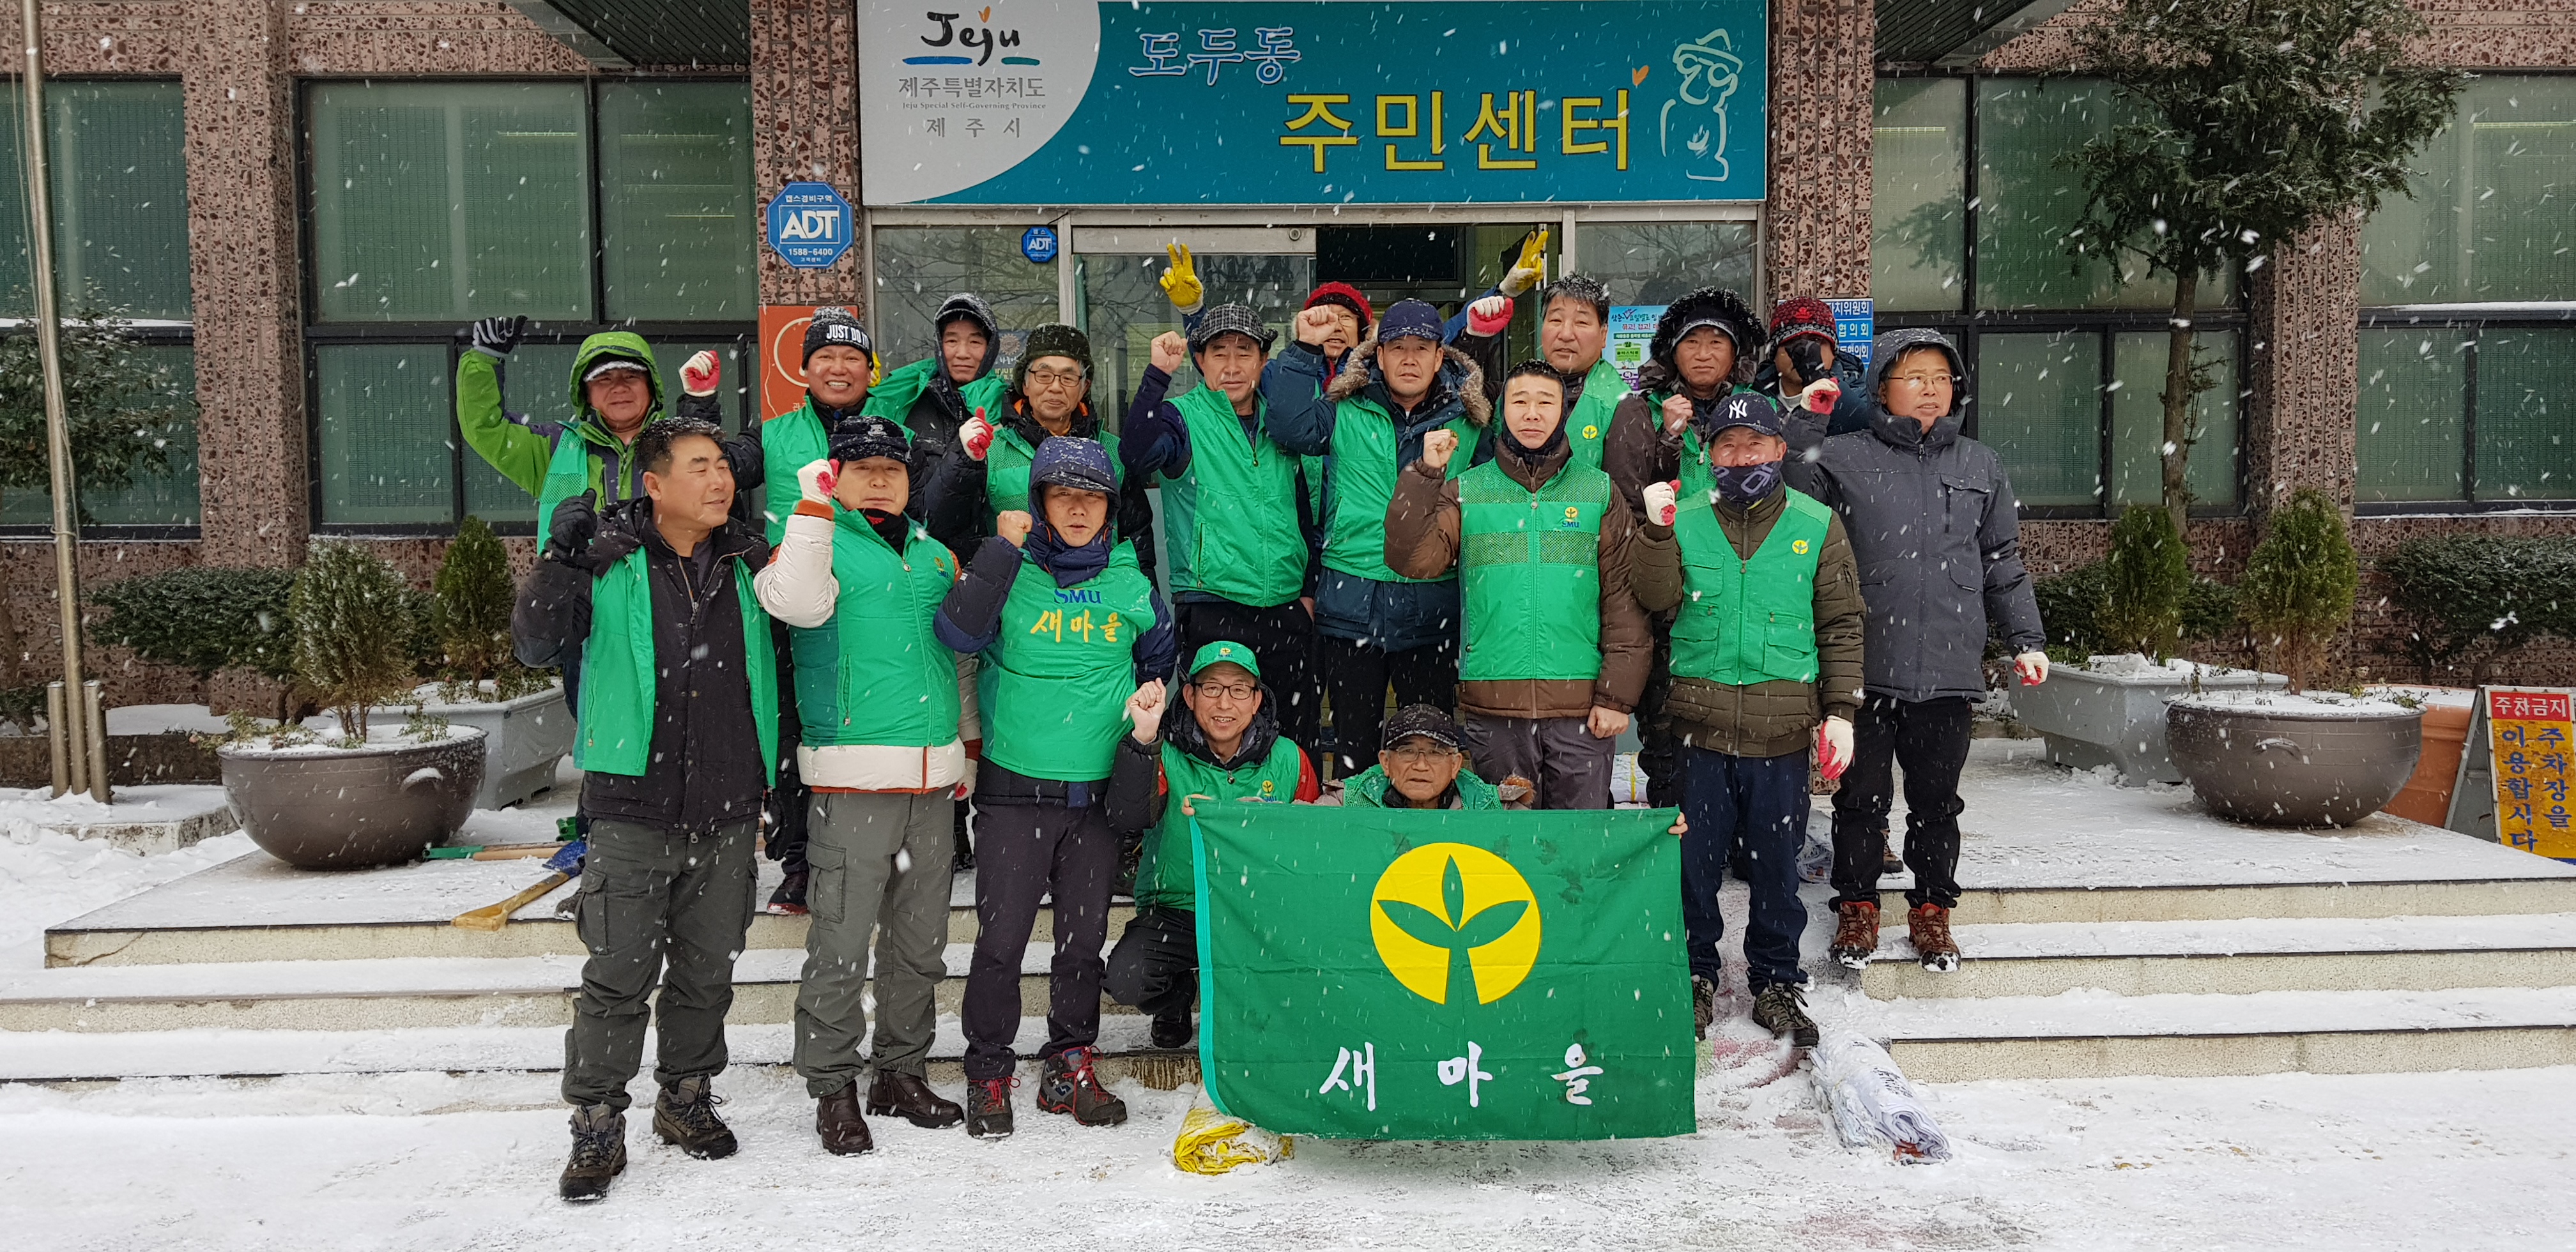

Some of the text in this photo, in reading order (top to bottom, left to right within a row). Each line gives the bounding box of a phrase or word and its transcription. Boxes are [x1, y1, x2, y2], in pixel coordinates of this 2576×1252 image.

[921, 9, 1020, 66] Jeju
[1128, 27, 1301, 86] 도두동
[898, 77, 1045, 98] 제주특별자치도
[1279, 89, 1629, 173] 주민센터
[781, 210, 839, 239] ADT
[1028, 238, 1052, 250] ADT
[826, 324, 848, 339] JUST
[850, 327, 862, 343] DO
[1054, 589, 1102, 604] SMU
[2495, 696, 2566, 717] 주차금지
